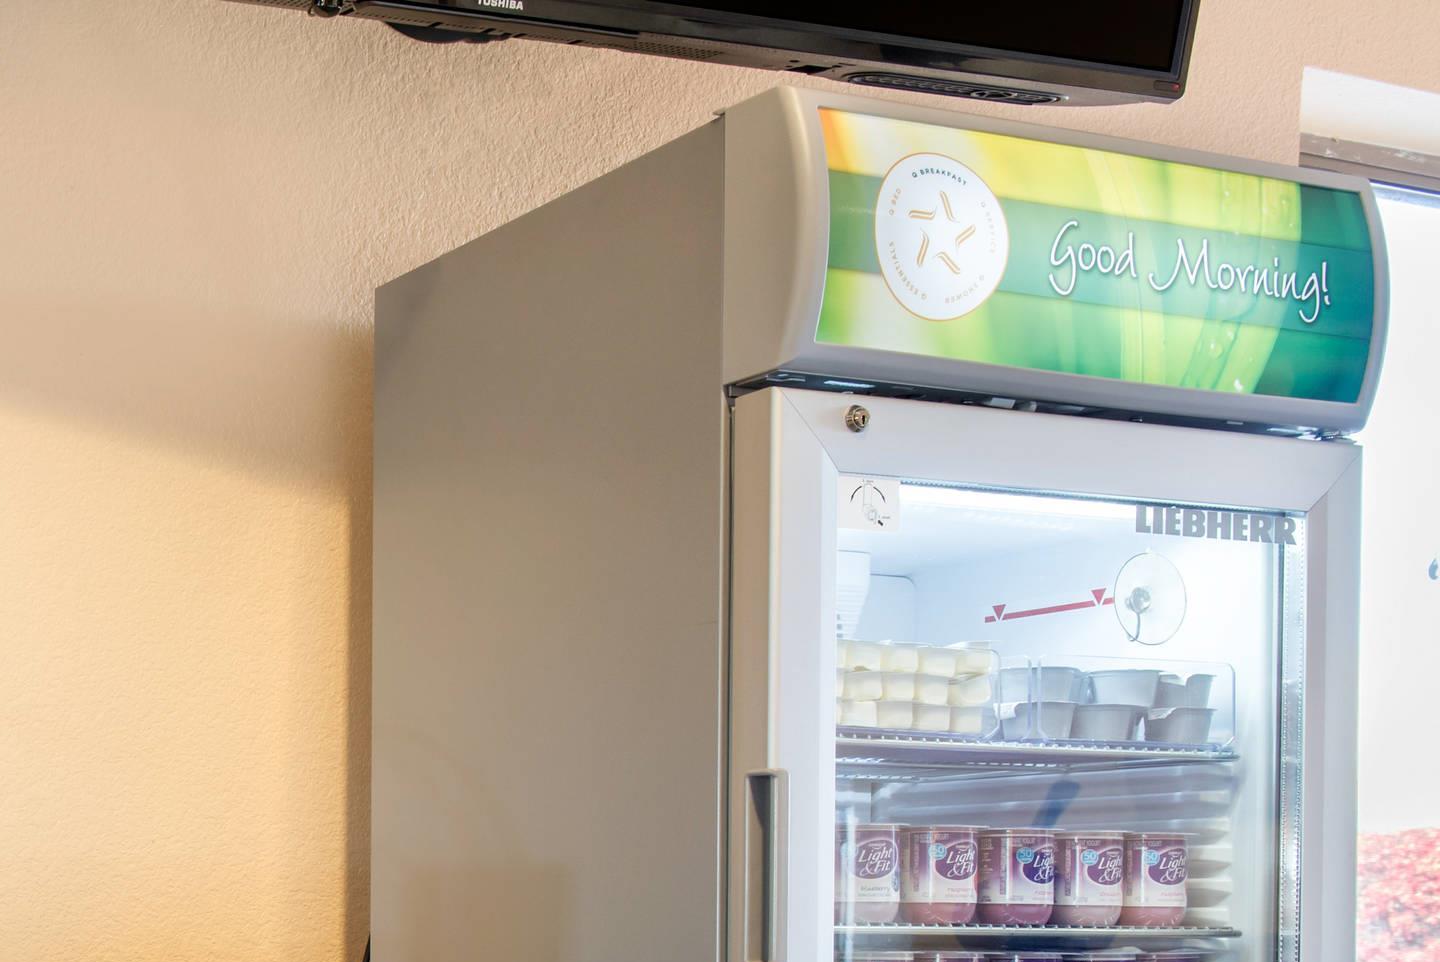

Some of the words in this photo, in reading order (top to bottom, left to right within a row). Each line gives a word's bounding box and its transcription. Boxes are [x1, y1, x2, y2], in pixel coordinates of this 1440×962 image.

[920, 167, 967, 186] BREAKFAST
[1048, 219, 1138, 297] Good
[1147, 237, 1333, 323] Morning!
[1135, 504, 1297, 546] LIEBHERR
[859, 847, 892, 865] Light
[946, 848, 976, 865] Light
[875, 860, 891, 873] Fit
[960, 861, 974, 873] Fit
